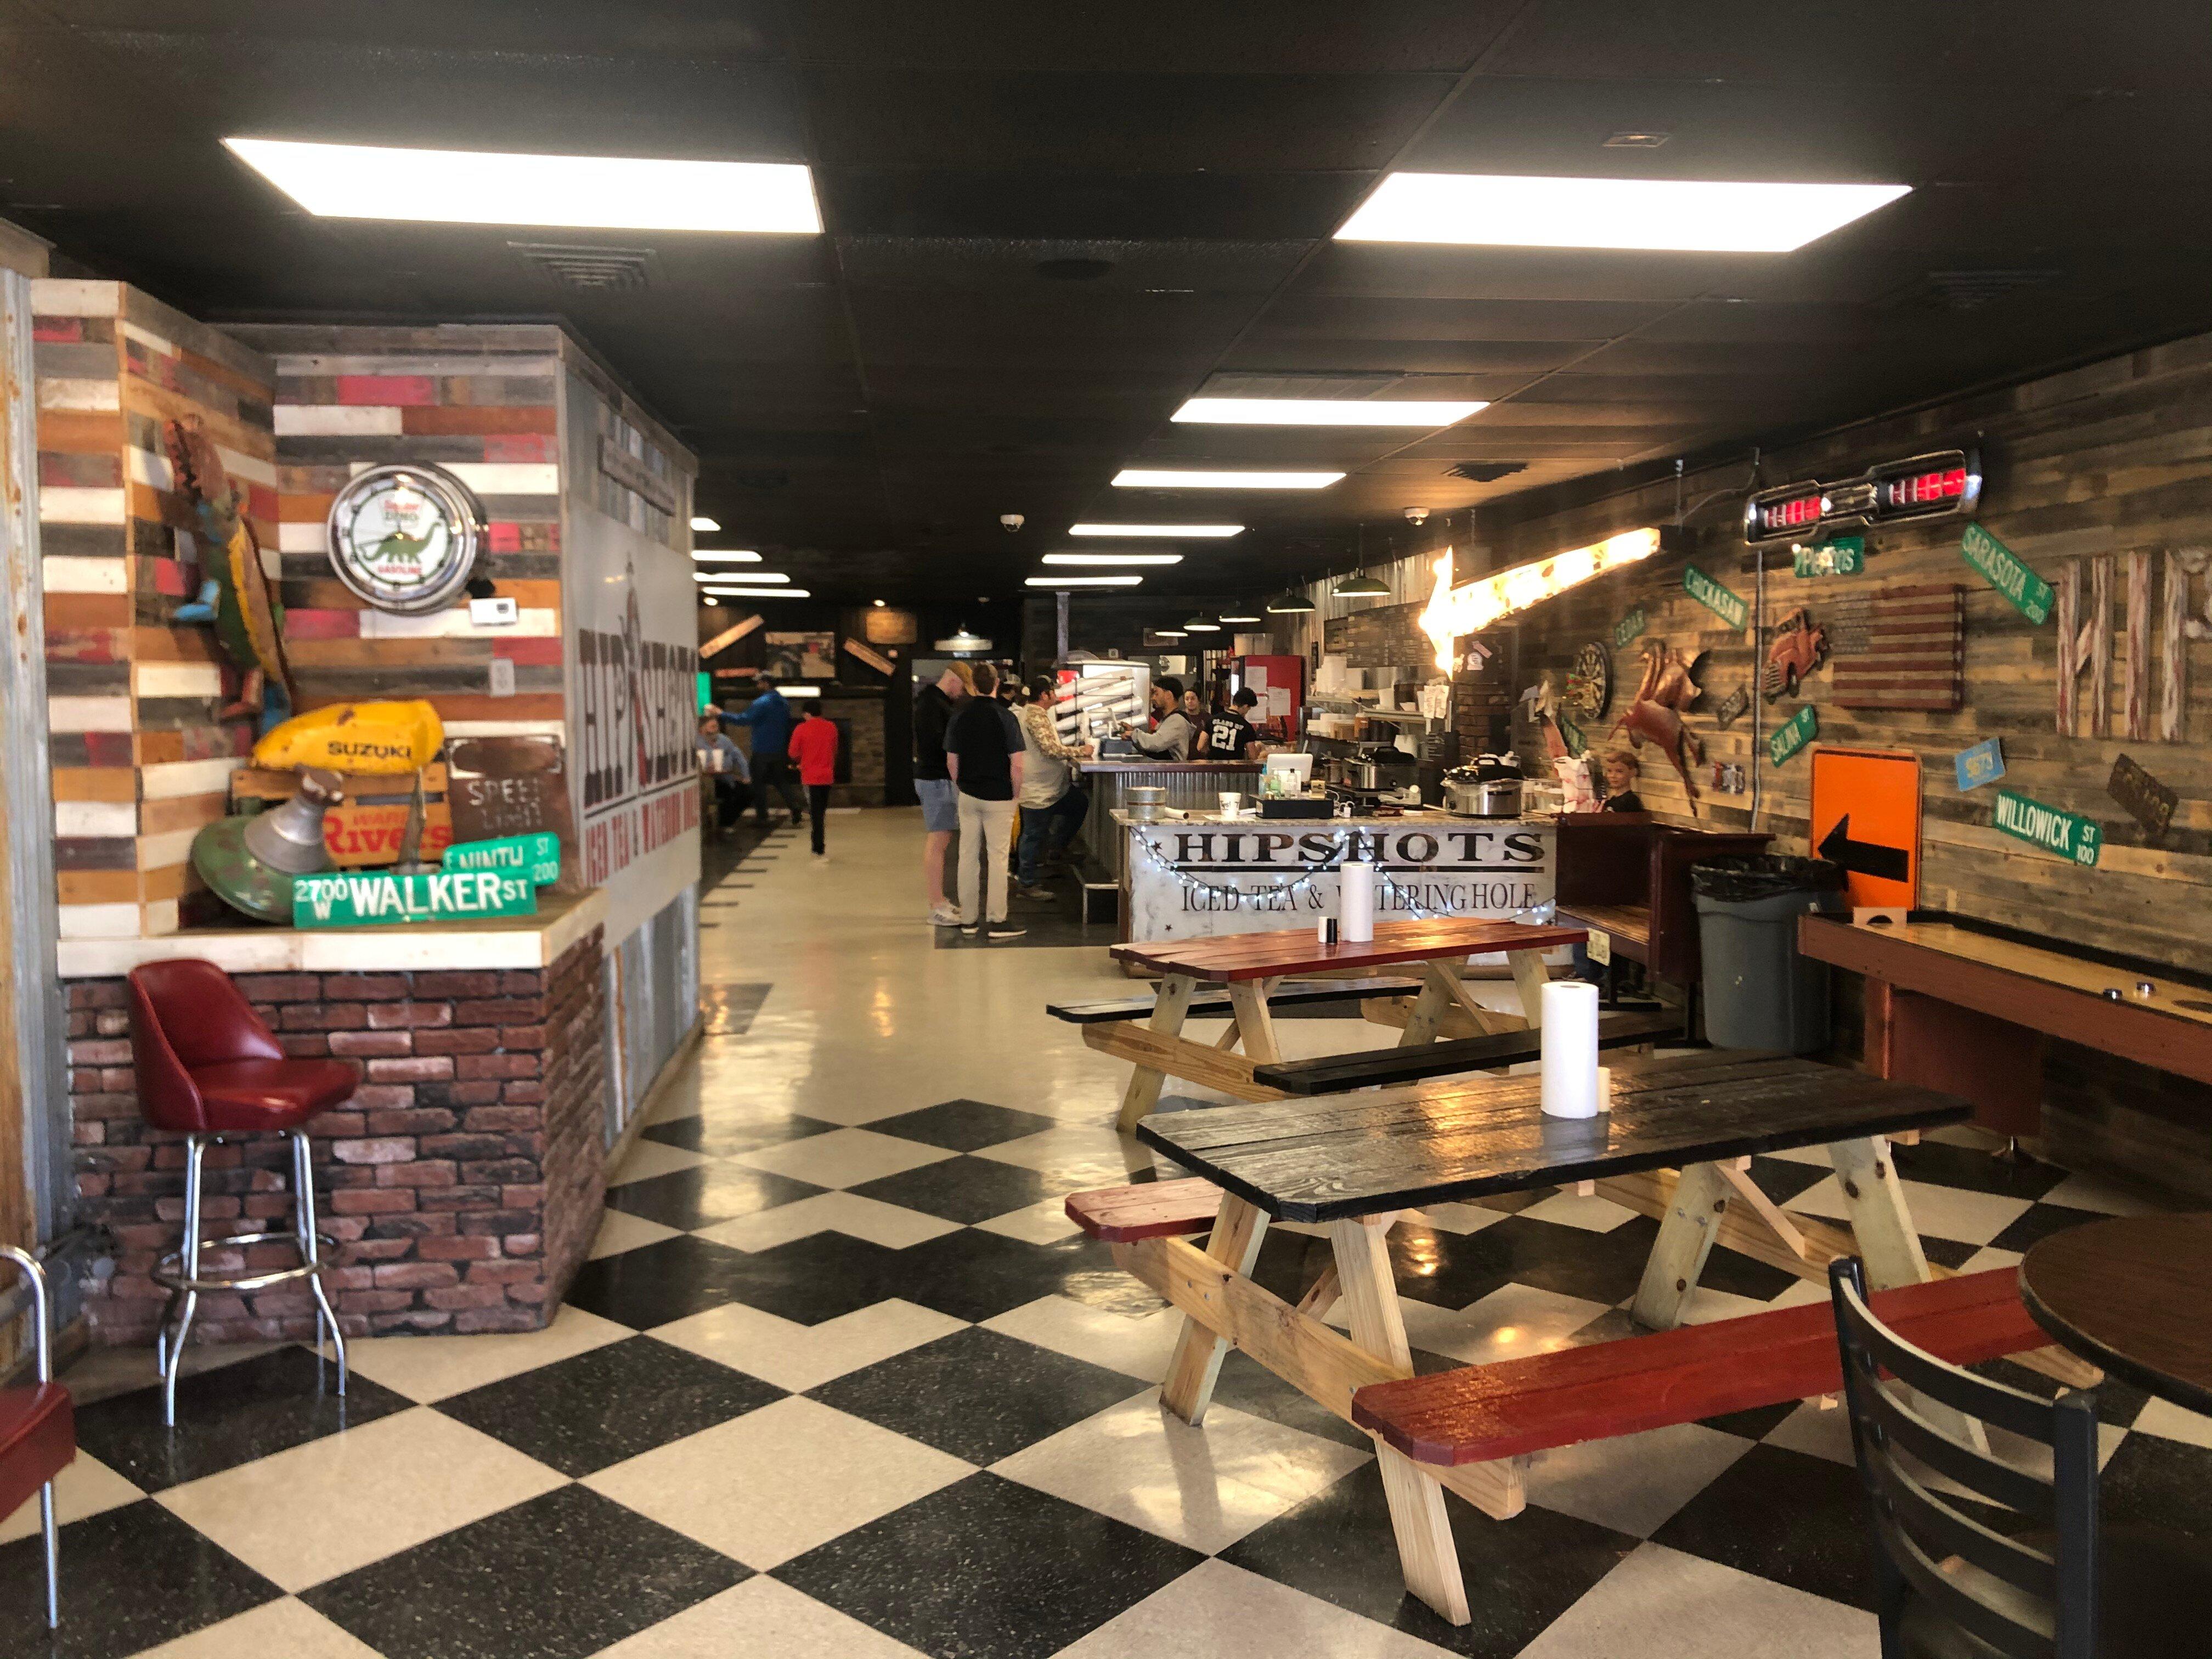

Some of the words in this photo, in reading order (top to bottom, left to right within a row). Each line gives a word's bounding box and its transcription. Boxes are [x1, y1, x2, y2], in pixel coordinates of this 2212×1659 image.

[1962, 527, 2026, 601] SARASOTA
[328, 740, 411, 759] SUZUKI
[1211, 725, 1237, 751] 21
[323, 814, 454, 855] Rives
[1997, 794, 2073, 851] WILLOWICK
[2082, 824, 2096, 843] ST
[1174, 833, 1545, 862] HIPSHOTS
[2076, 844, 2095, 865] 100
[294, 877, 348, 903] 2700
[348, 872, 504, 917] WALKER
[503, 879, 528, 901] ST
[1182, 885, 1239, 911] ICED
[1250, 884, 1298, 911] TEA
[1308, 884, 1325, 910] &
[1336, 883, 1467, 911] TERING
[1471, 882, 1536, 909] HOLE
[313, 901, 332, 921] W
